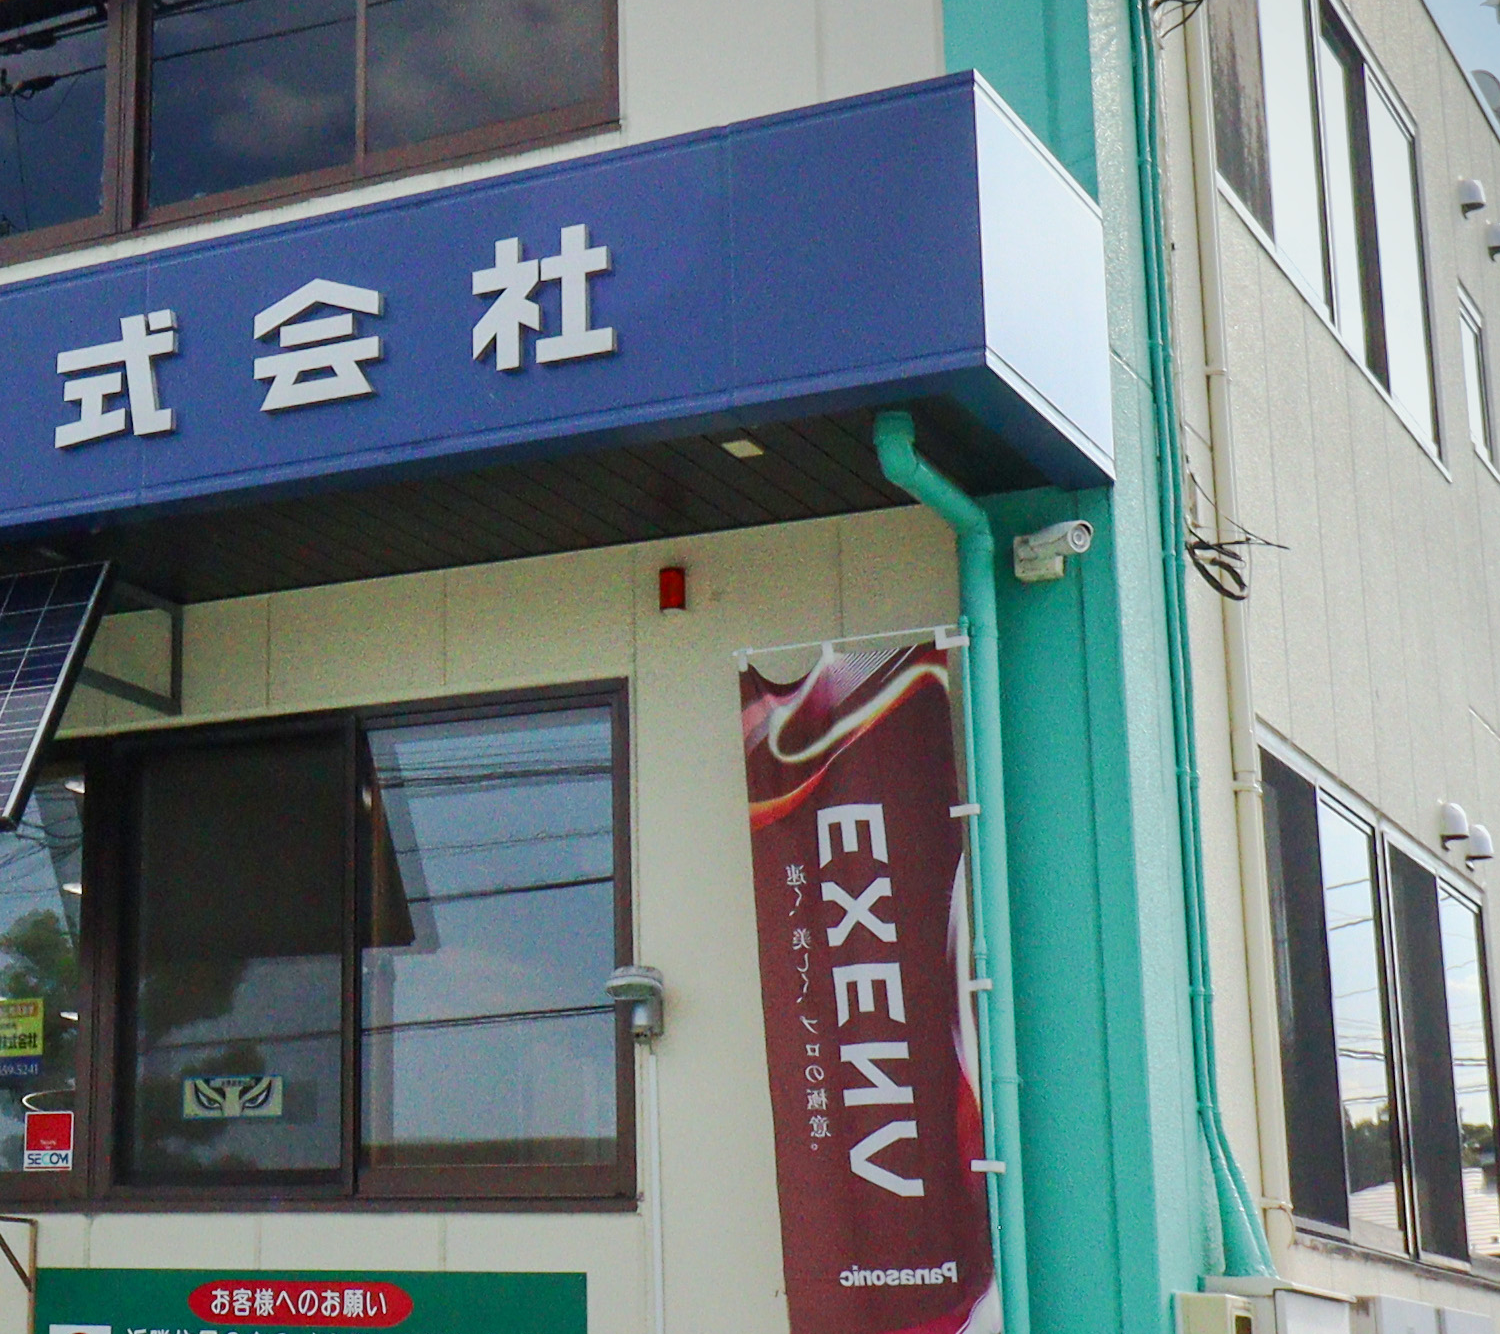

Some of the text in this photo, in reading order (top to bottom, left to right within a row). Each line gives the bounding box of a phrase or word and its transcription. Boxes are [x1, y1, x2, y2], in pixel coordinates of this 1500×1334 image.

[28, 1152, 69, 1165] SECOM
[210, 1287, 388, 1318] お客様へのお願い
